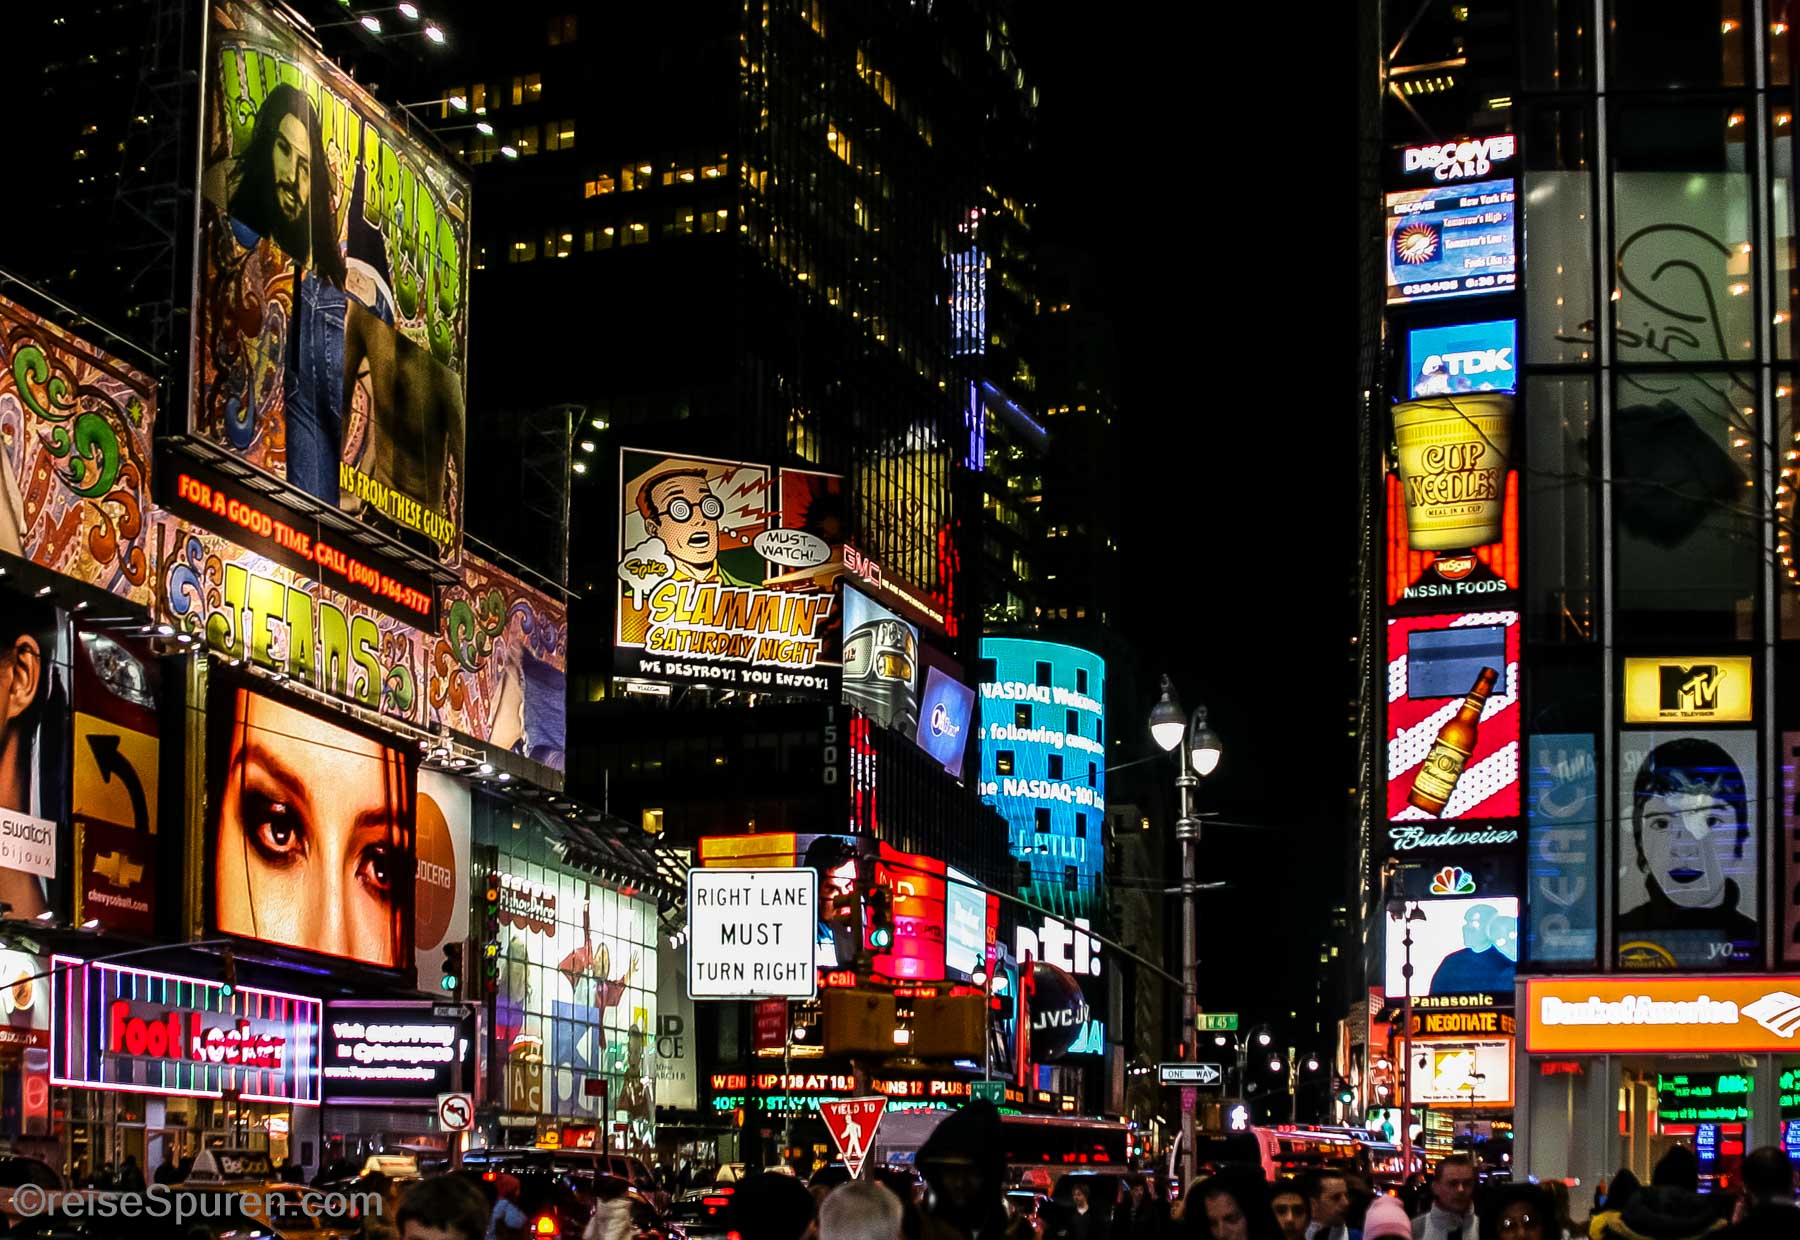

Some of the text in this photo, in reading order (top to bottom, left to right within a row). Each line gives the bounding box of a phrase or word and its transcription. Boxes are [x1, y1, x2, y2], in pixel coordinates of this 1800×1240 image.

[1435, 160, 1490, 180] CARD
[1442, 348, 1513, 375] TDK
[1421, 441, 1486, 474] CUP
[357, 471, 388, 511] FROM
[390, 490, 421, 529] THESE
[179, 474, 211, 509] FOR
[212, 490, 226, 516] A
[228, 498, 273, 538] GOOD
[273, 520, 313, 560] TIME,
[314, 542, 347, 575] CALL
[347, 560, 380, 596] (800)
[625, 558, 668, 579] Spike
[844, 544, 880, 587] GMC
[1438, 559, 1471, 572] NISSIN
[1404, 580, 1507, 598] NISSIN FOODS
[651, 582, 833, 637] SLAMMIN'
[206, 563, 381, 709] JEANS
[650, 627, 819, 664] SATURDAY NIGHT
[639, 660, 828, 690] WE DESTROY! YOU ENJOY!
[979, 682, 1051, 704] NASDAQ
[1660, 665, 1727, 710] MTV
[990, 723, 1064, 748] following
[1003, 778, 1092, 806] NASDAQ-100
[2, 820, 52, 846] swatch
[1388, 826, 1518, 850] Budweiser
[2, 844, 51, 866] bijoux
[698, 888, 807, 906] RIGHT LANE
[721, 923, 783, 945] MUST
[697, 963, 808, 980] TURN RIGHT
[829, 971, 856, 987] call
[1411, 993, 1493, 1007] Panasonic
[1033, 1002, 1090, 1029] JVC JV
[1208, 1016, 1216, 1028] W
[1217, 1016, 1227, 1027] 45
[1426, 1013, 1498, 1032] NEGOTIATE
[111, 1001, 182, 1058] Foot
[759, 1075, 778, 1089] UP
[806, 1075, 828, 1089] AT
[1196, 1071, 1213, 1079] WAY
[931, 1080, 963, 1095] PLUS
[831, 1103, 860, 1115] YIELD
[864, 1102, 875, 1112] TO
